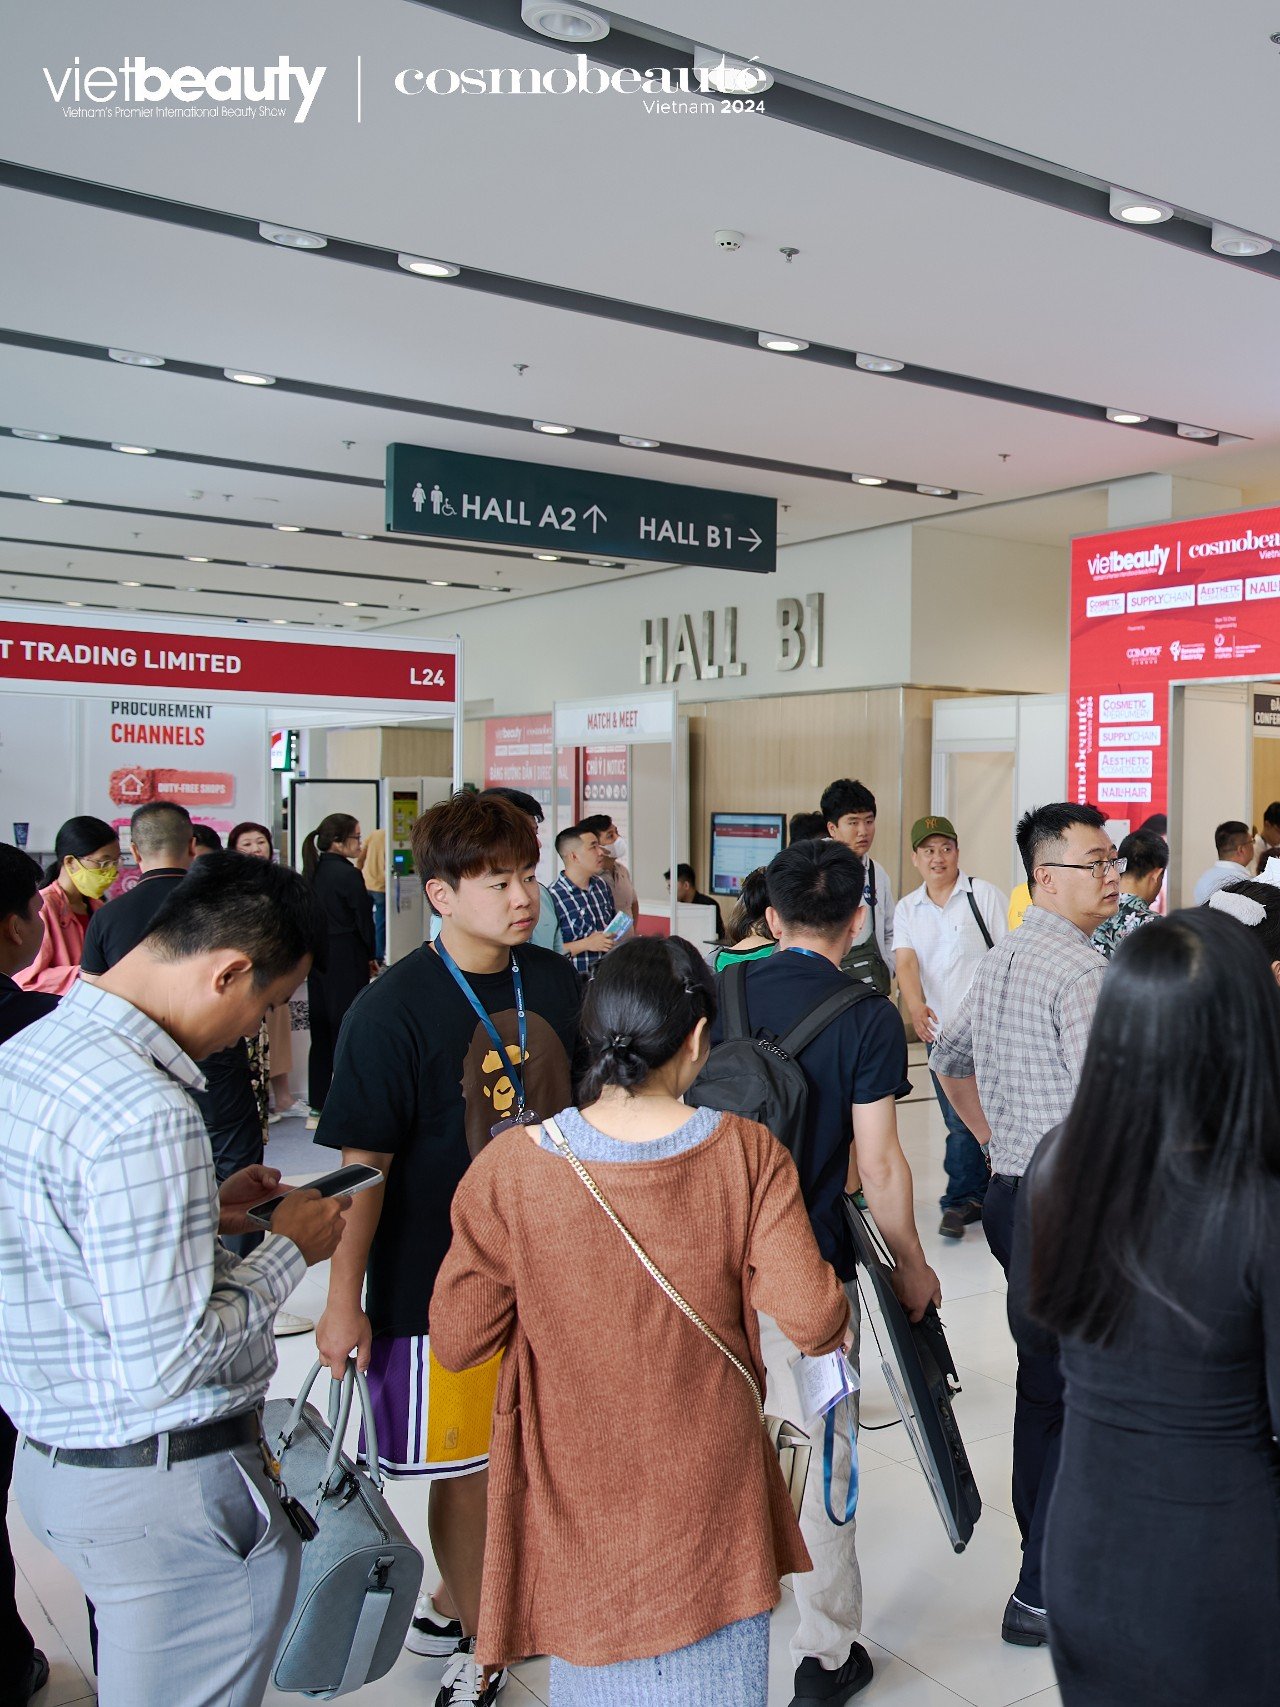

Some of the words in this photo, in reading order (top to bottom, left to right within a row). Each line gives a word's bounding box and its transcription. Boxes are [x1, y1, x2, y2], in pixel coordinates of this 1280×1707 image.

[462, 493, 531, 527] HALL
[539, 504, 576, 532] A2
[639, 516, 699, 546] HALL
[707, 526, 732, 550] B1
[1087, 544, 1170, 576] vietbeauty
[639, 606, 747, 685] HALL
[776, 592, 824, 672] B1
[0, 639, 14, 660] T
[21, 641, 137, 668] TRADING
[145, 650, 242, 675] LIMITED
[410, 668, 446, 687] L24
[111, 701, 213, 719] PROCUREMENT
[587, 713, 611, 730] MATCH
[620, 710, 638, 728] MEET
[111, 723, 205, 746] CHANNELS
[158, 783, 199, 793] DUTY-FREE
[200, 784, 226, 794] SHOPS
